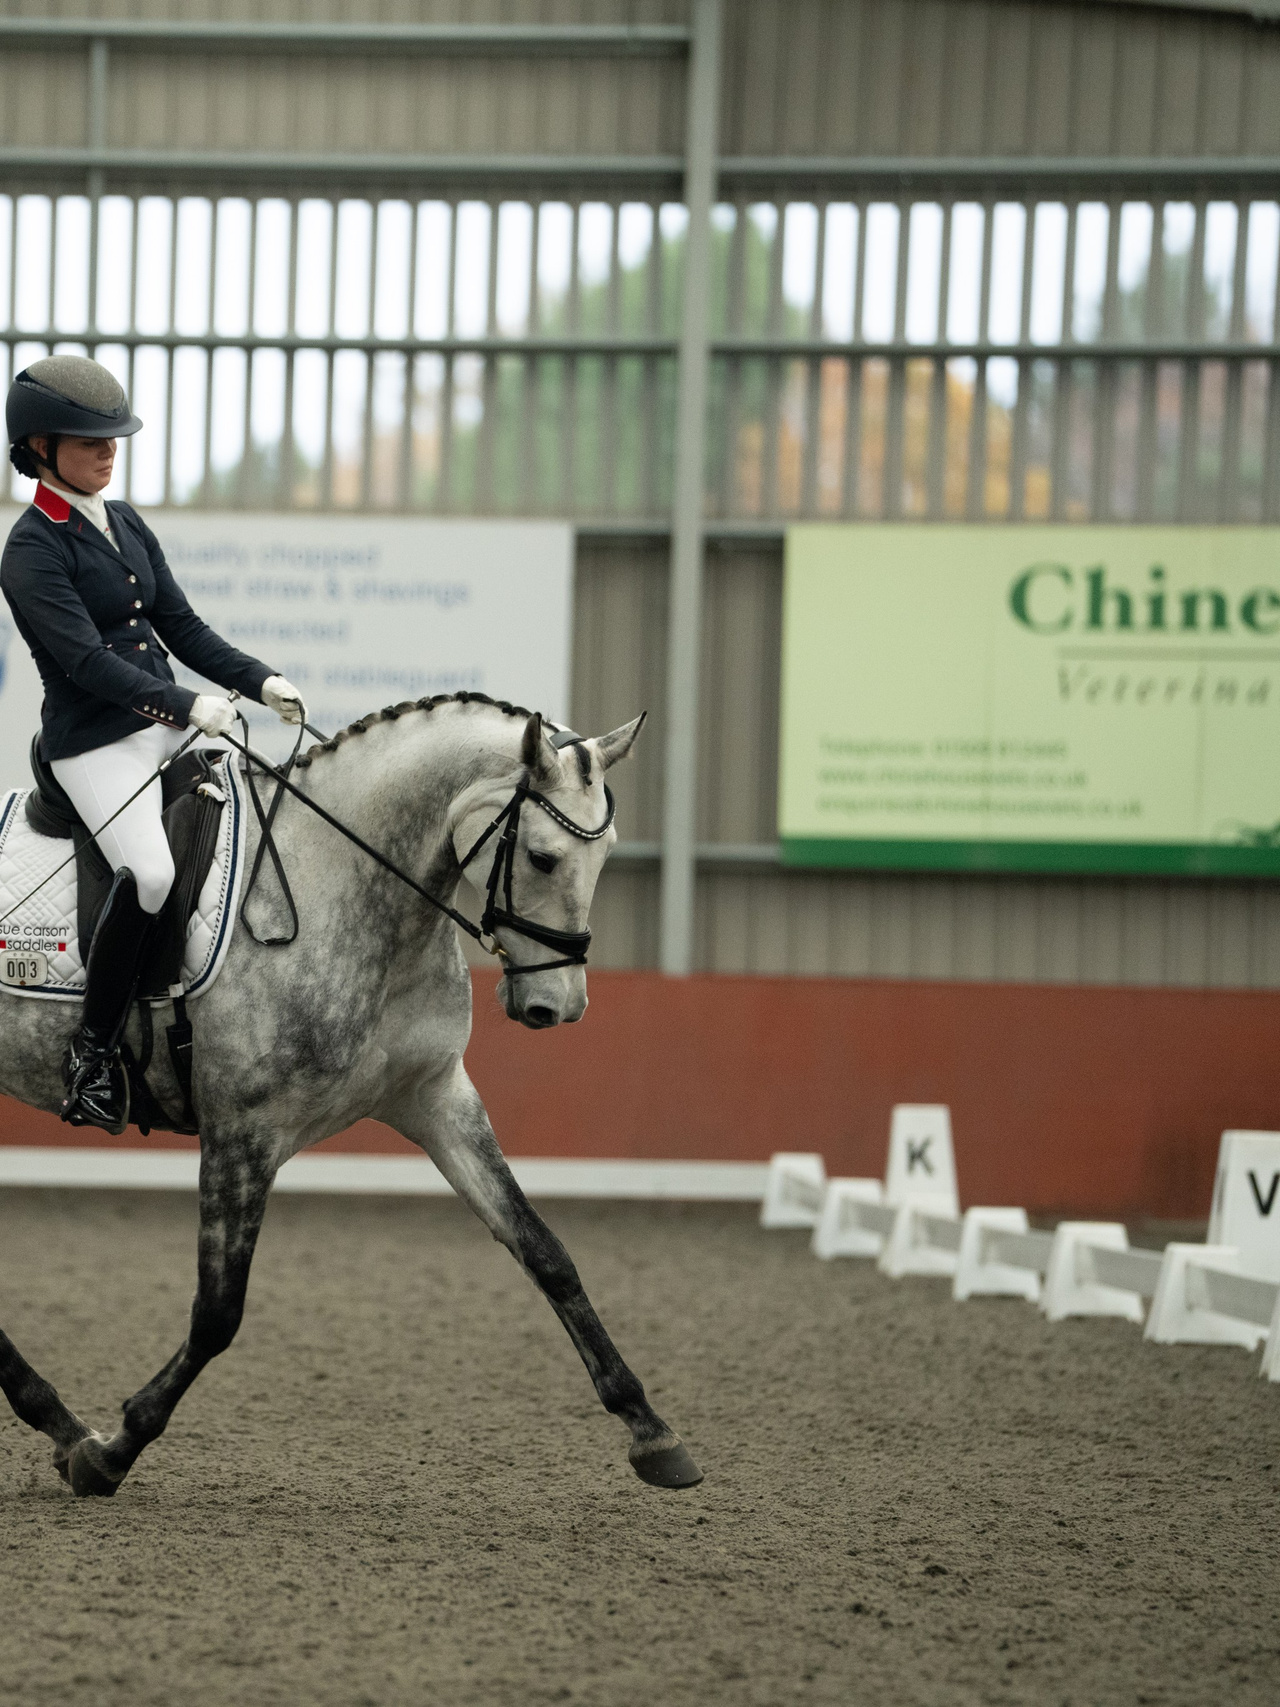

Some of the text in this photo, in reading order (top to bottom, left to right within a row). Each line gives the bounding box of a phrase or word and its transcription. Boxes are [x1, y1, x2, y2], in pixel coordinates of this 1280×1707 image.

[1008, 561, 1280, 636] Chine
[7, 939, 58, 951] saddles
[23, 925, 68, 937] carson
[7, 961, 37, 978] 003
[906, 1136, 935, 1176] K
[1246, 1168, 1280, 1217] V
